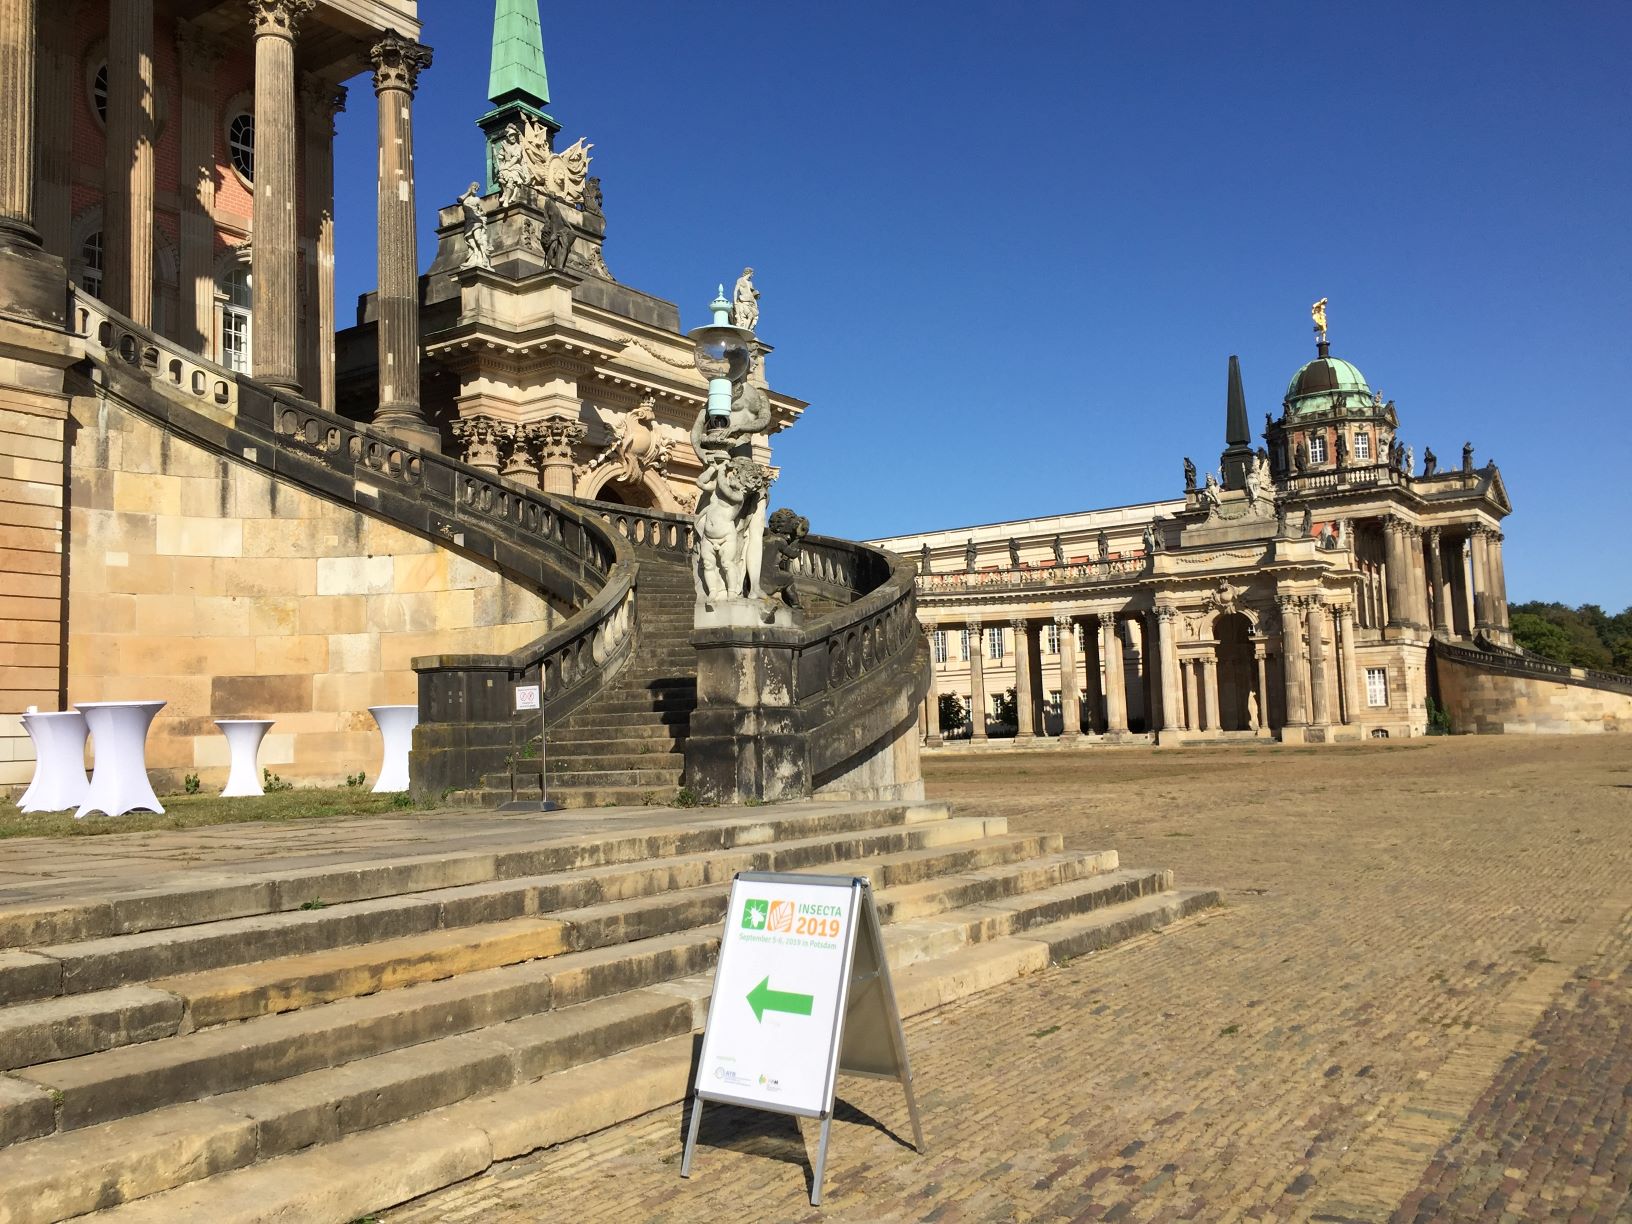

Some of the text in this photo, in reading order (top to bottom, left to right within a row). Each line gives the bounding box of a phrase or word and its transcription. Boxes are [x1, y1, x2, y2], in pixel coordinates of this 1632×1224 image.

[798, 903, 842, 917] INSECTA
[795, 916, 840, 938] 2019
[739, 932, 772, 943] September
[785, 937, 801, 947] 2019
[809, 939, 837, 950] Potsdam
